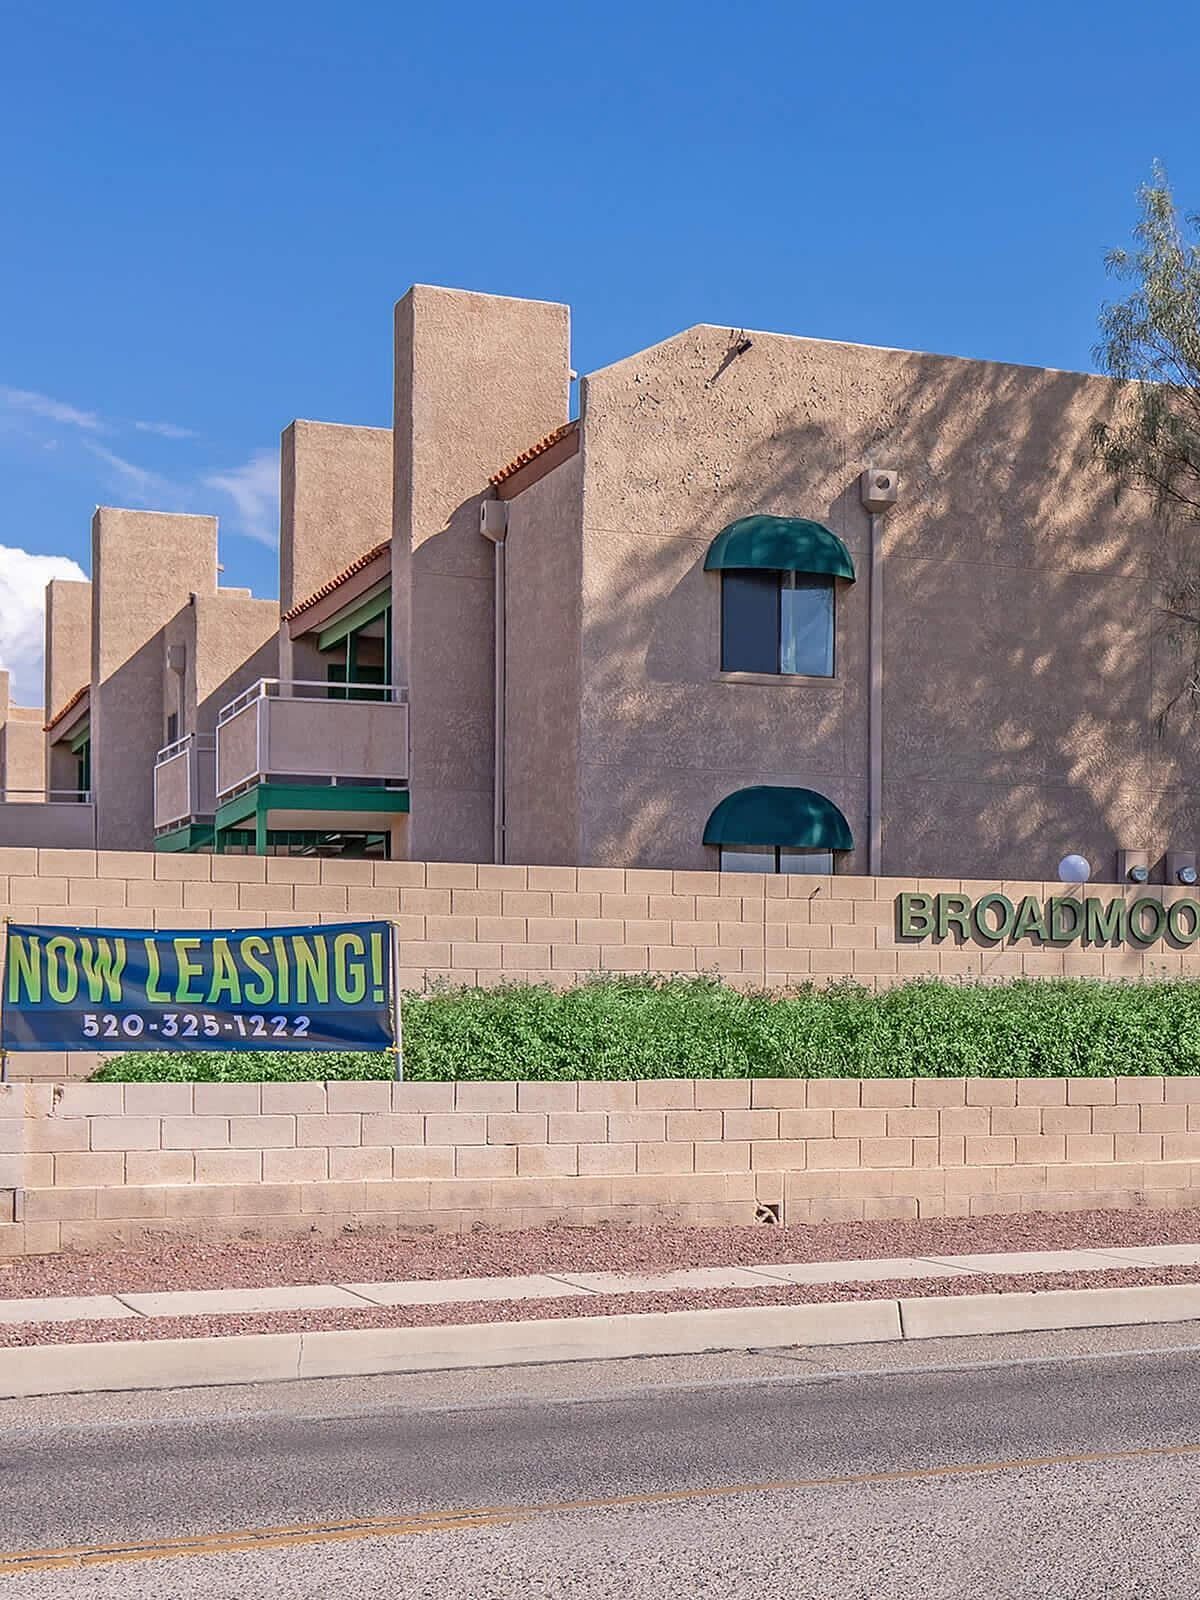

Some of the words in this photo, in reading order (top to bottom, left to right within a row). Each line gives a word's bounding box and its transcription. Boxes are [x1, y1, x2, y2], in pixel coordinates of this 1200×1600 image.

[9, 934, 127, 1004] NOW
[145, 932, 385, 1005] LEASING!
[82, 1013, 311, 1038] 520-325-1222
